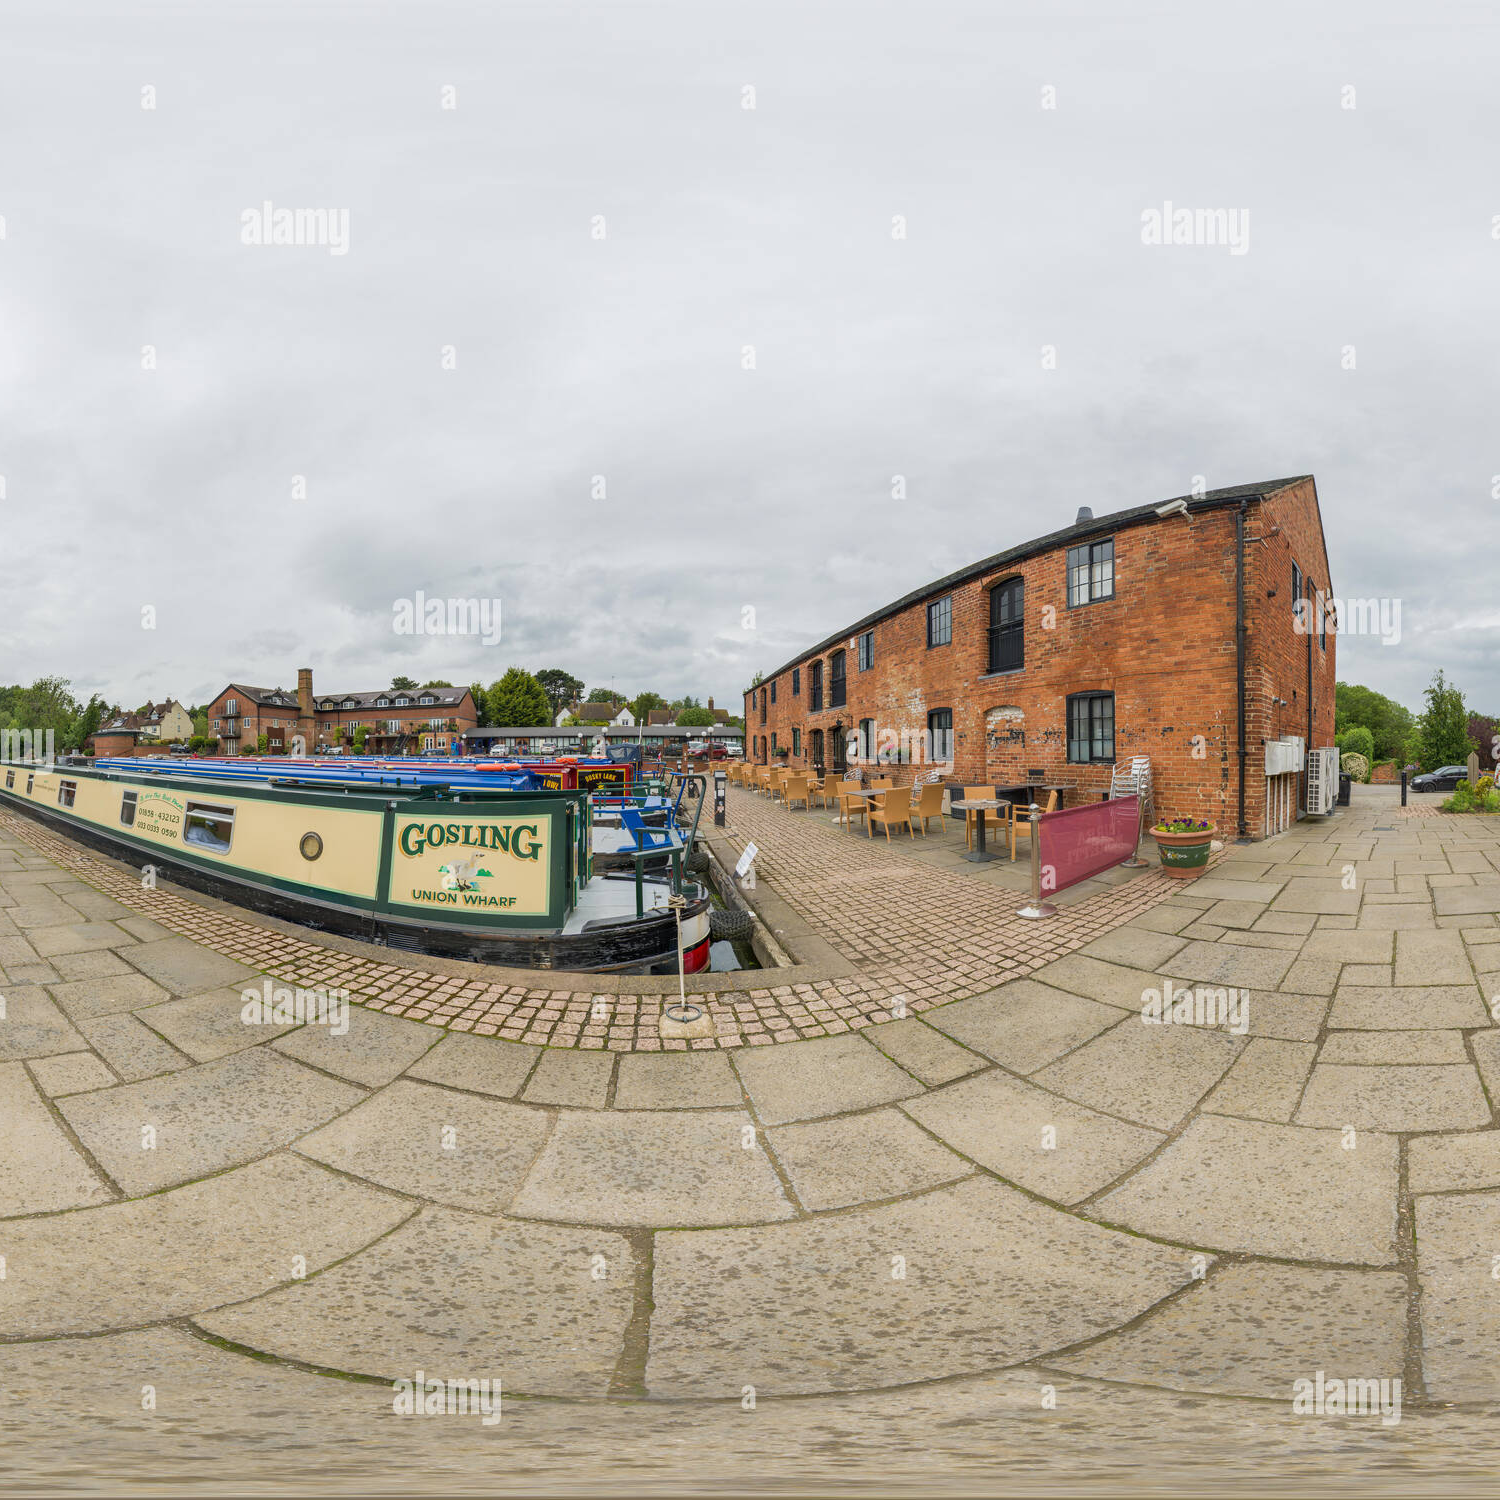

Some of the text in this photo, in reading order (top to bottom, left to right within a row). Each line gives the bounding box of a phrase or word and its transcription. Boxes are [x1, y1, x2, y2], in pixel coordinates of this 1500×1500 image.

[157, 812, 180, 824] 432123
[399, 823, 543, 862] GOSLING
[412, 889, 517, 908] UNION WHARF
